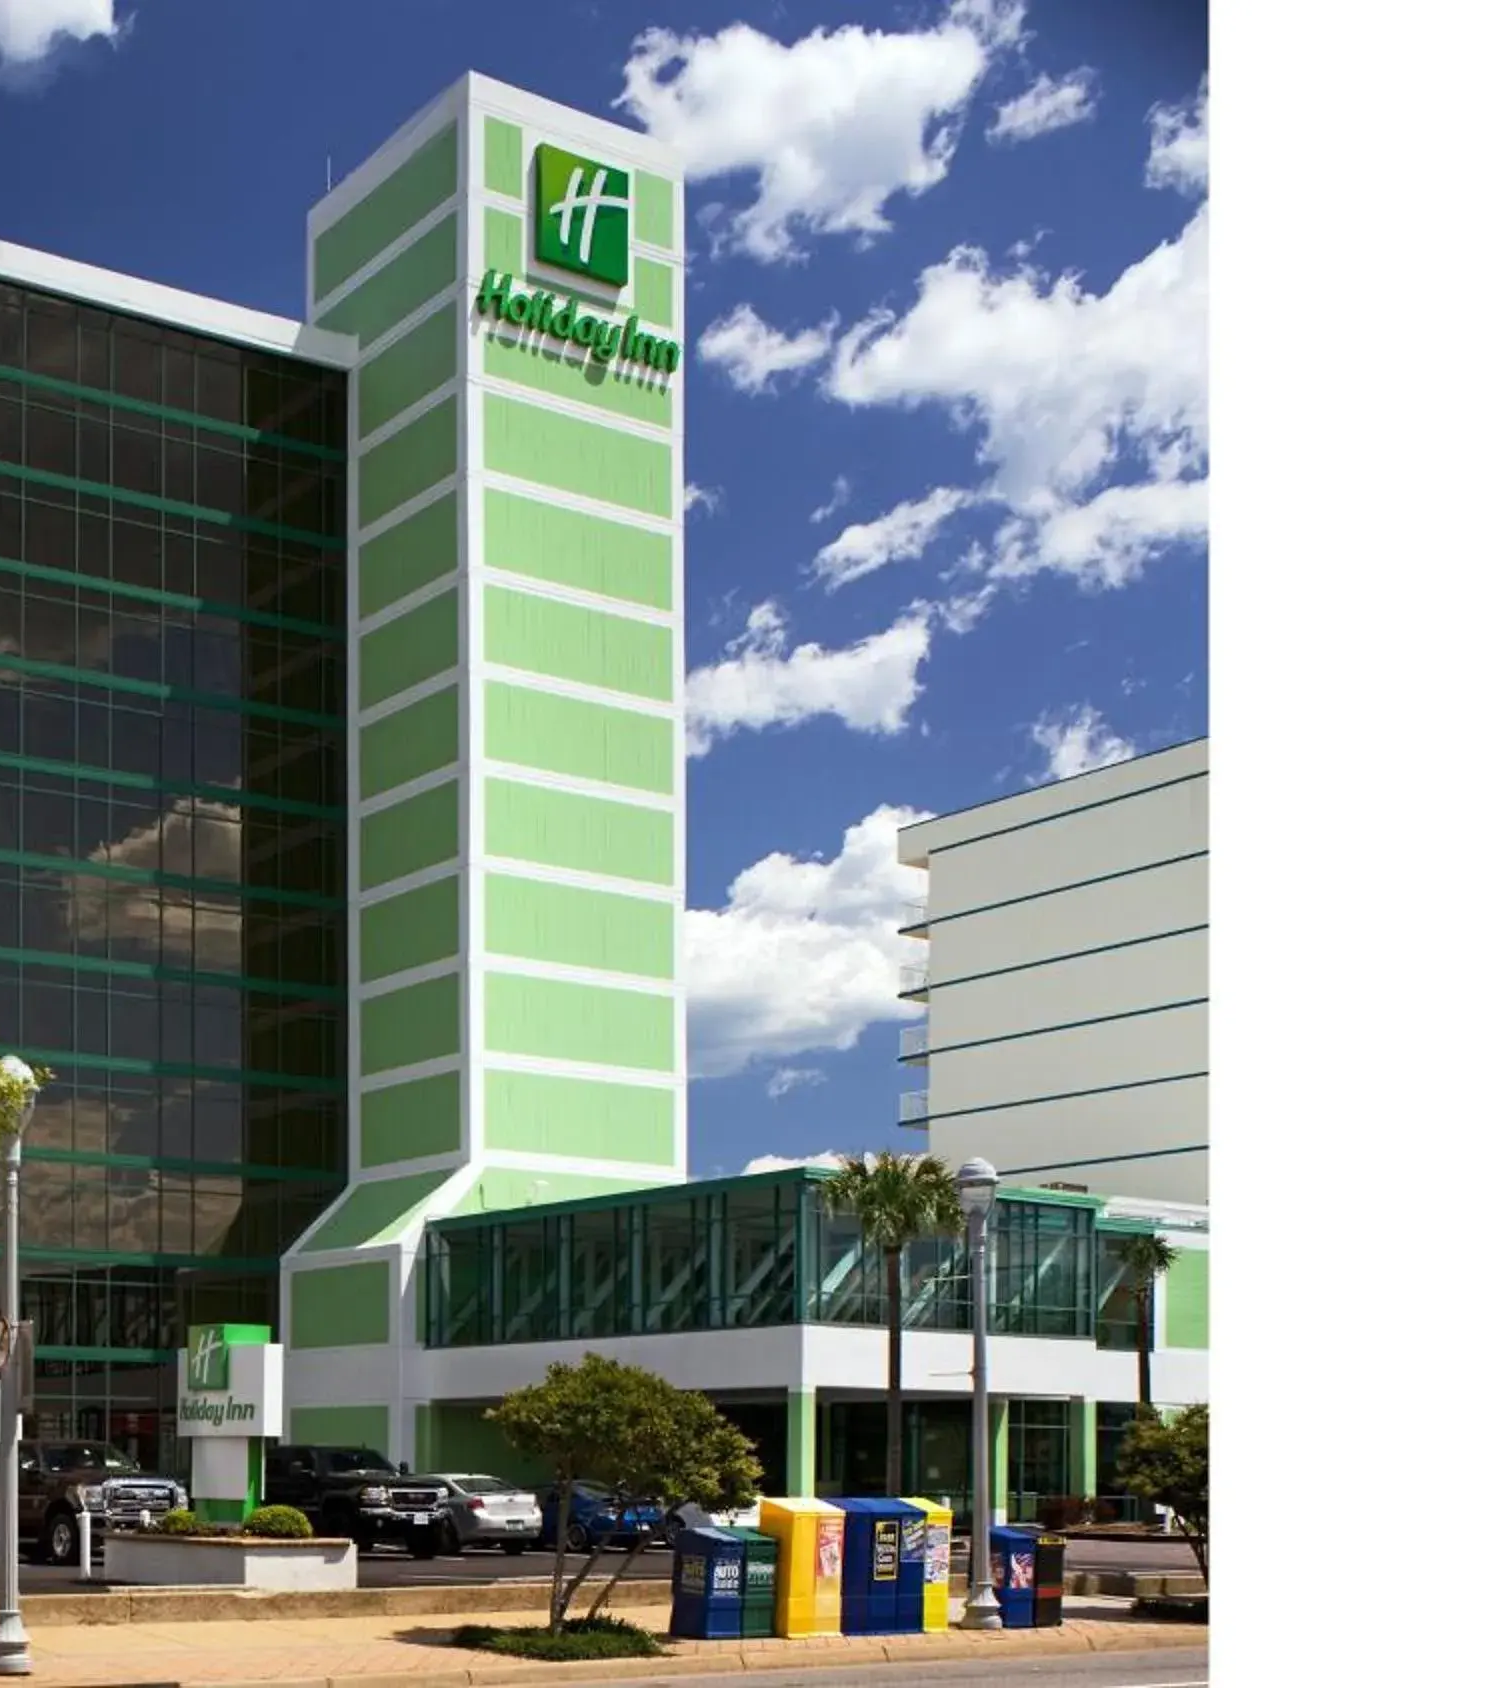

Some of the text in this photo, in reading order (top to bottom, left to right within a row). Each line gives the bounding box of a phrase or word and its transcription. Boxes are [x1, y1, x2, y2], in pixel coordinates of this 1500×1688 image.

[476, 268, 681, 374] Holiday Inn
[179, 1396, 256, 1427] Holiday Inn
[713, 1564, 740, 1580] AUTO
